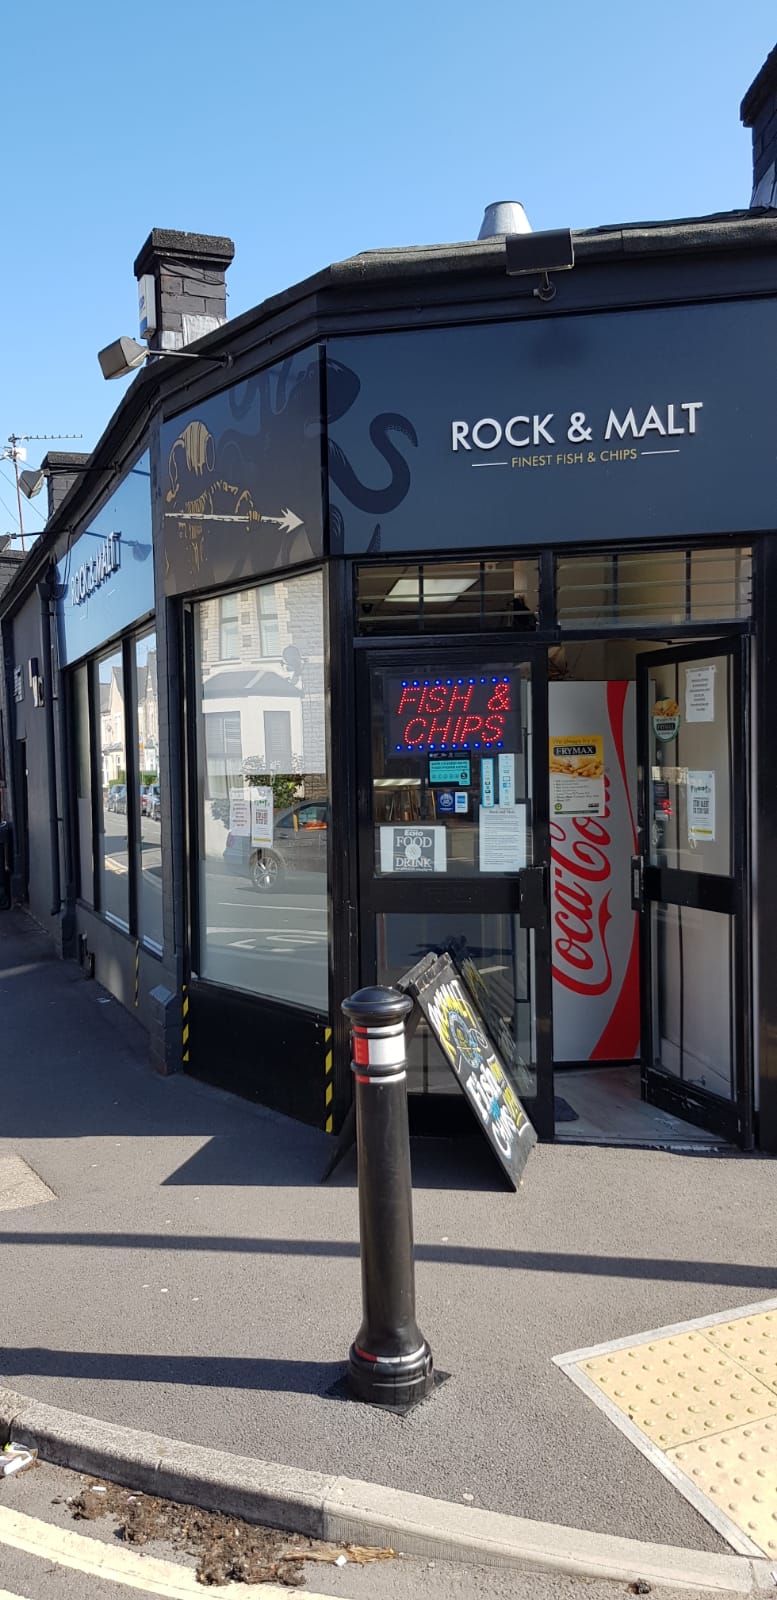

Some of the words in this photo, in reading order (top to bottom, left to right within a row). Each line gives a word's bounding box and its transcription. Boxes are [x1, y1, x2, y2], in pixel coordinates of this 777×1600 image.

[451, 414, 556, 451] ROCK
[567, 411, 593, 443] &
[604, 402, 703, 440] MALT
[511, 455, 553, 468] FINEST
[556, 453, 583, 464] FISH
[587, 452, 596, 463] &
[600, 449, 638, 462] CHIPS
[397, 684, 475, 715] FISH
[486, 682, 511, 711] &
[403, 714, 505, 744] CHIPS
[556, 746, 594, 755] FRYMAX
[396, 836, 432, 848] FOOD
[396, 857, 431, 868] DRINK
[550, 775, 612, 996] Coca-Co
[466, 1061, 503, 1125] Fish
